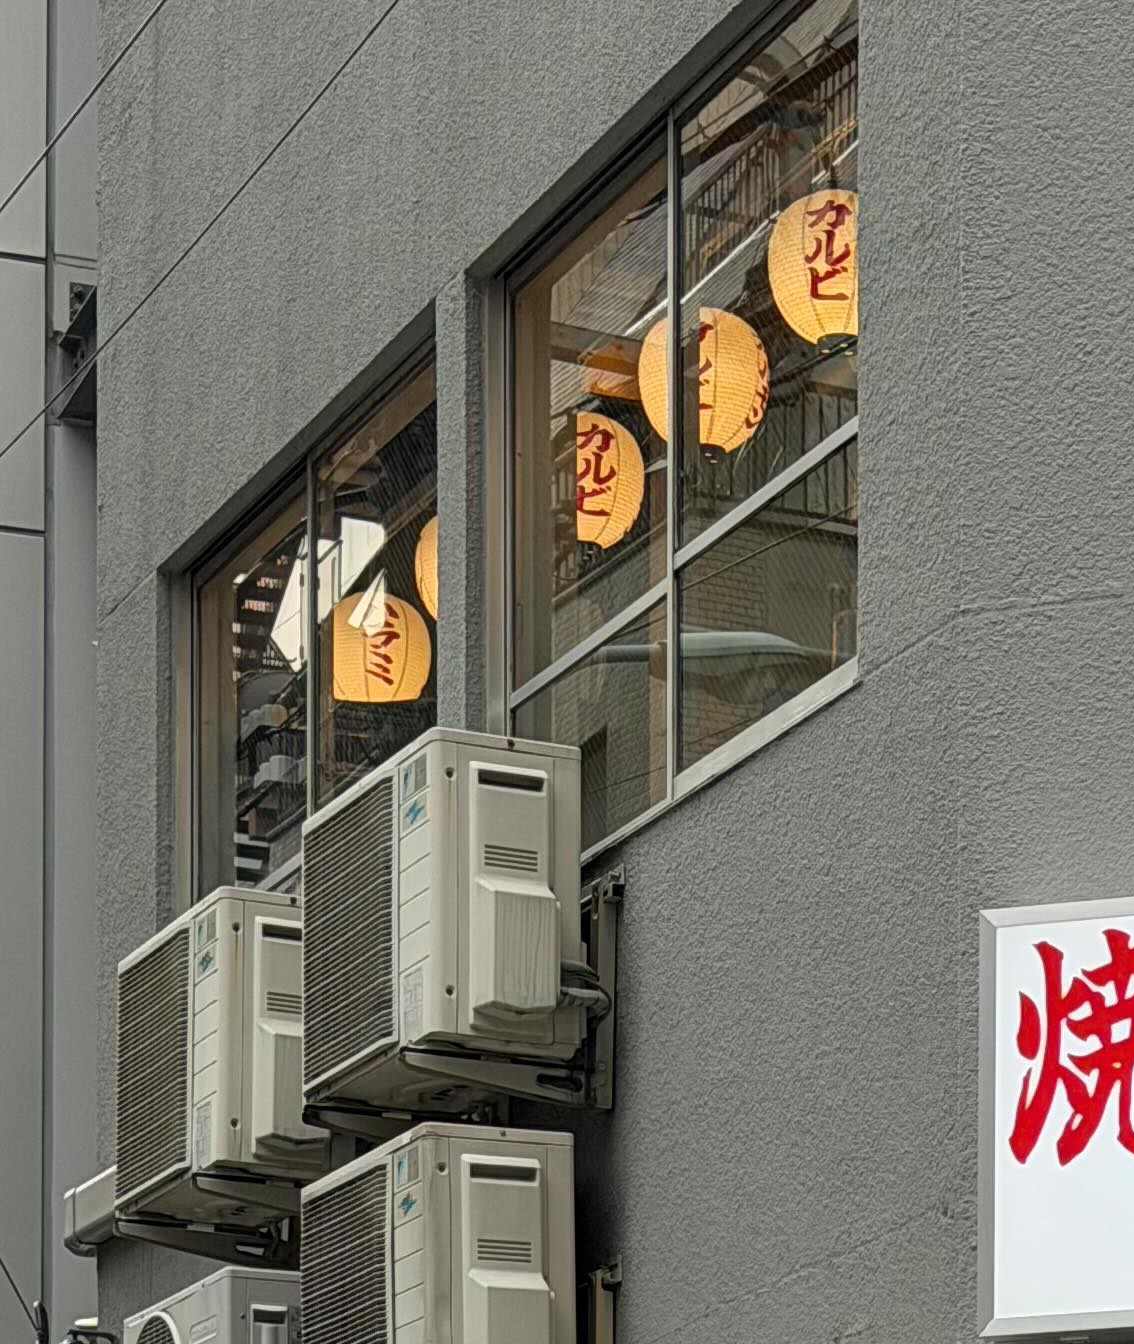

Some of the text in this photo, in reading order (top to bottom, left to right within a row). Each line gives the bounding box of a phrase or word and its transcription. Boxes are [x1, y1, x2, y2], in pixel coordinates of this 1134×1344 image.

[804, 199, 853, 302] カルビ
[577, 423, 617, 517] カルビ
